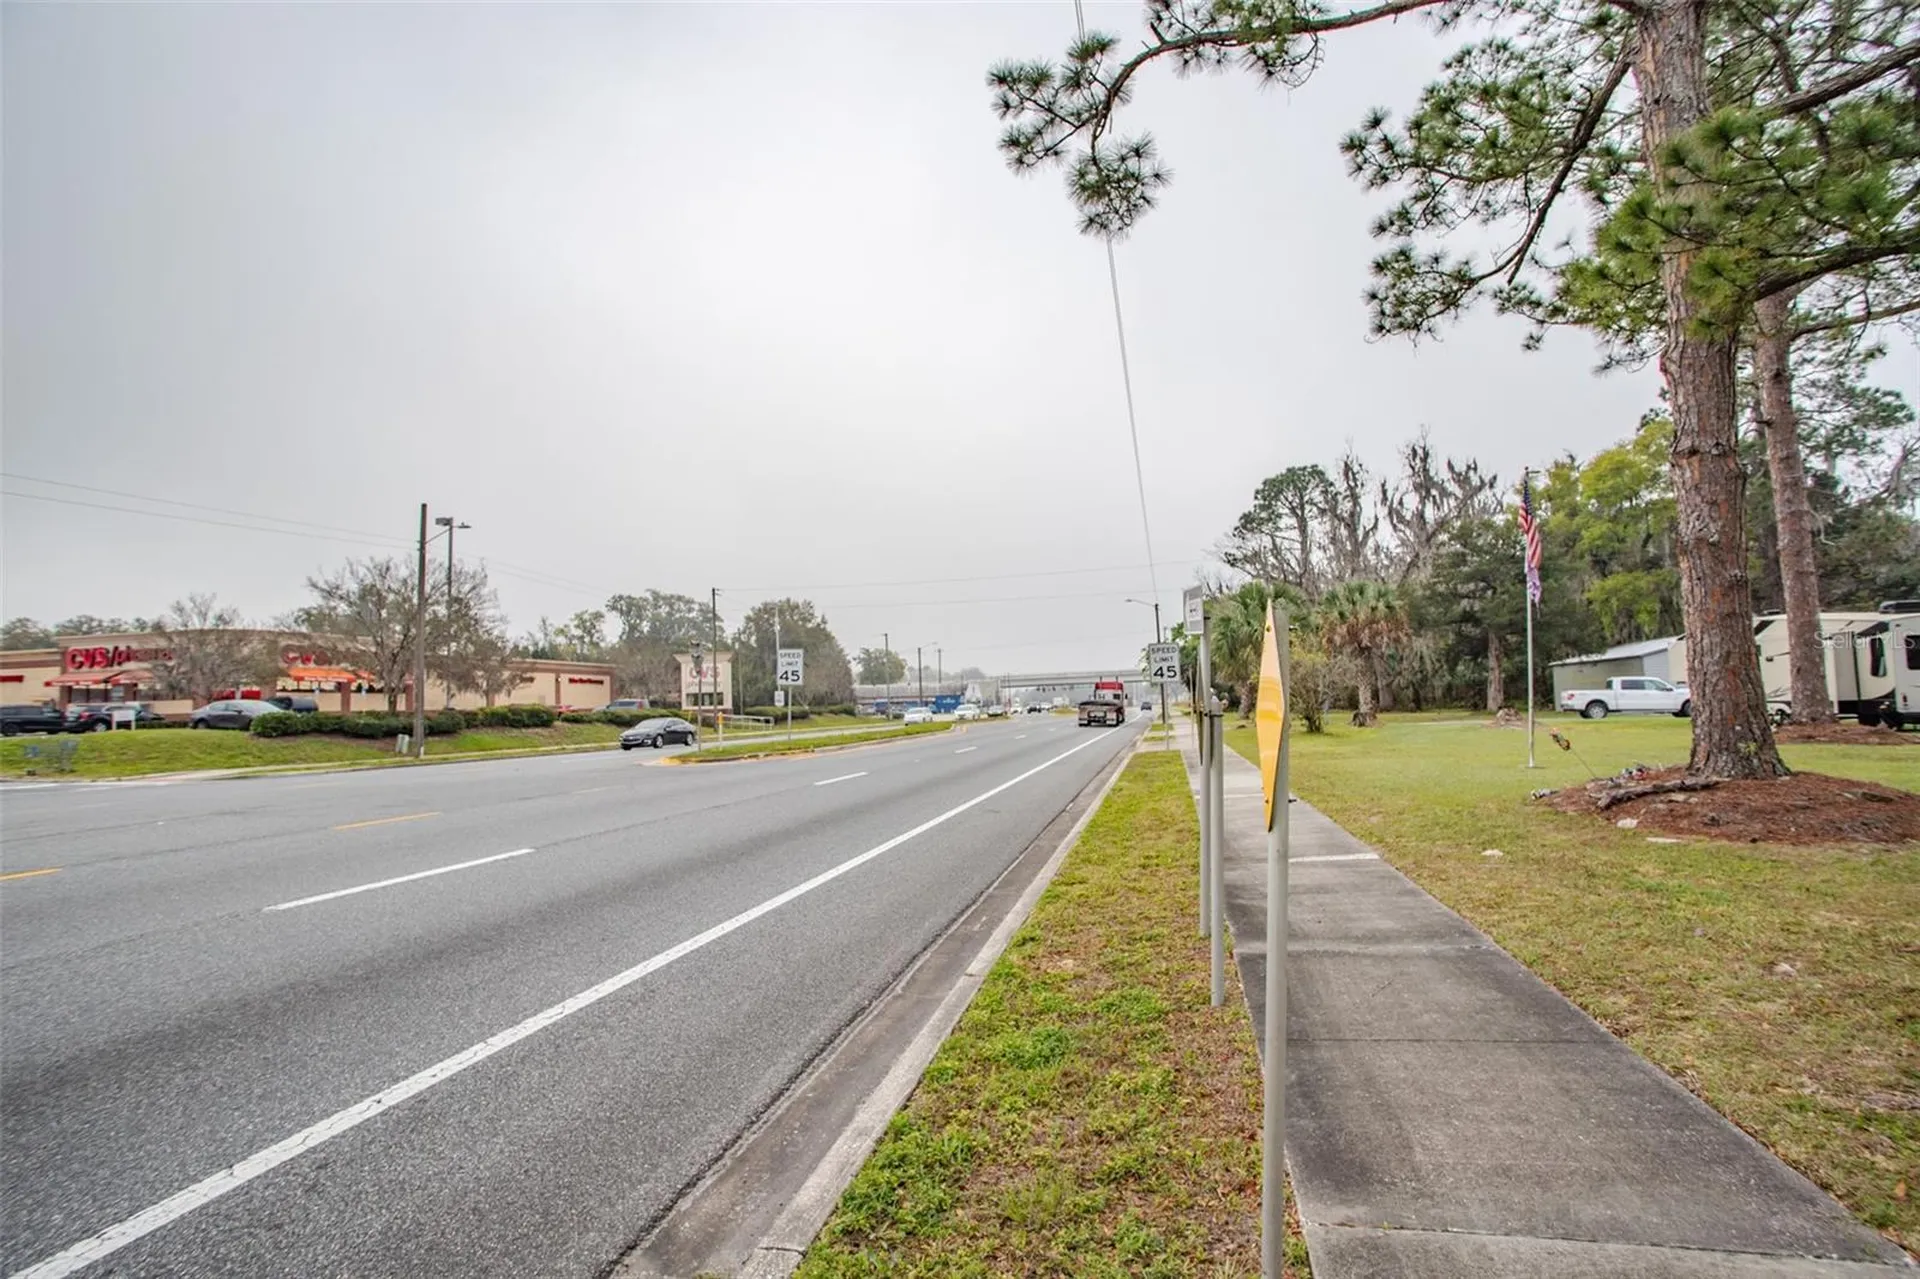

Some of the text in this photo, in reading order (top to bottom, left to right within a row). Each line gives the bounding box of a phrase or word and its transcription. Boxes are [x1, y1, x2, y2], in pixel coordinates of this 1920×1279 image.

[780, 651, 801, 659] SPEED
[1151, 646, 1177, 654] SPEED
[779, 670, 801, 682] 45
[1153, 665, 1177, 678] 45
